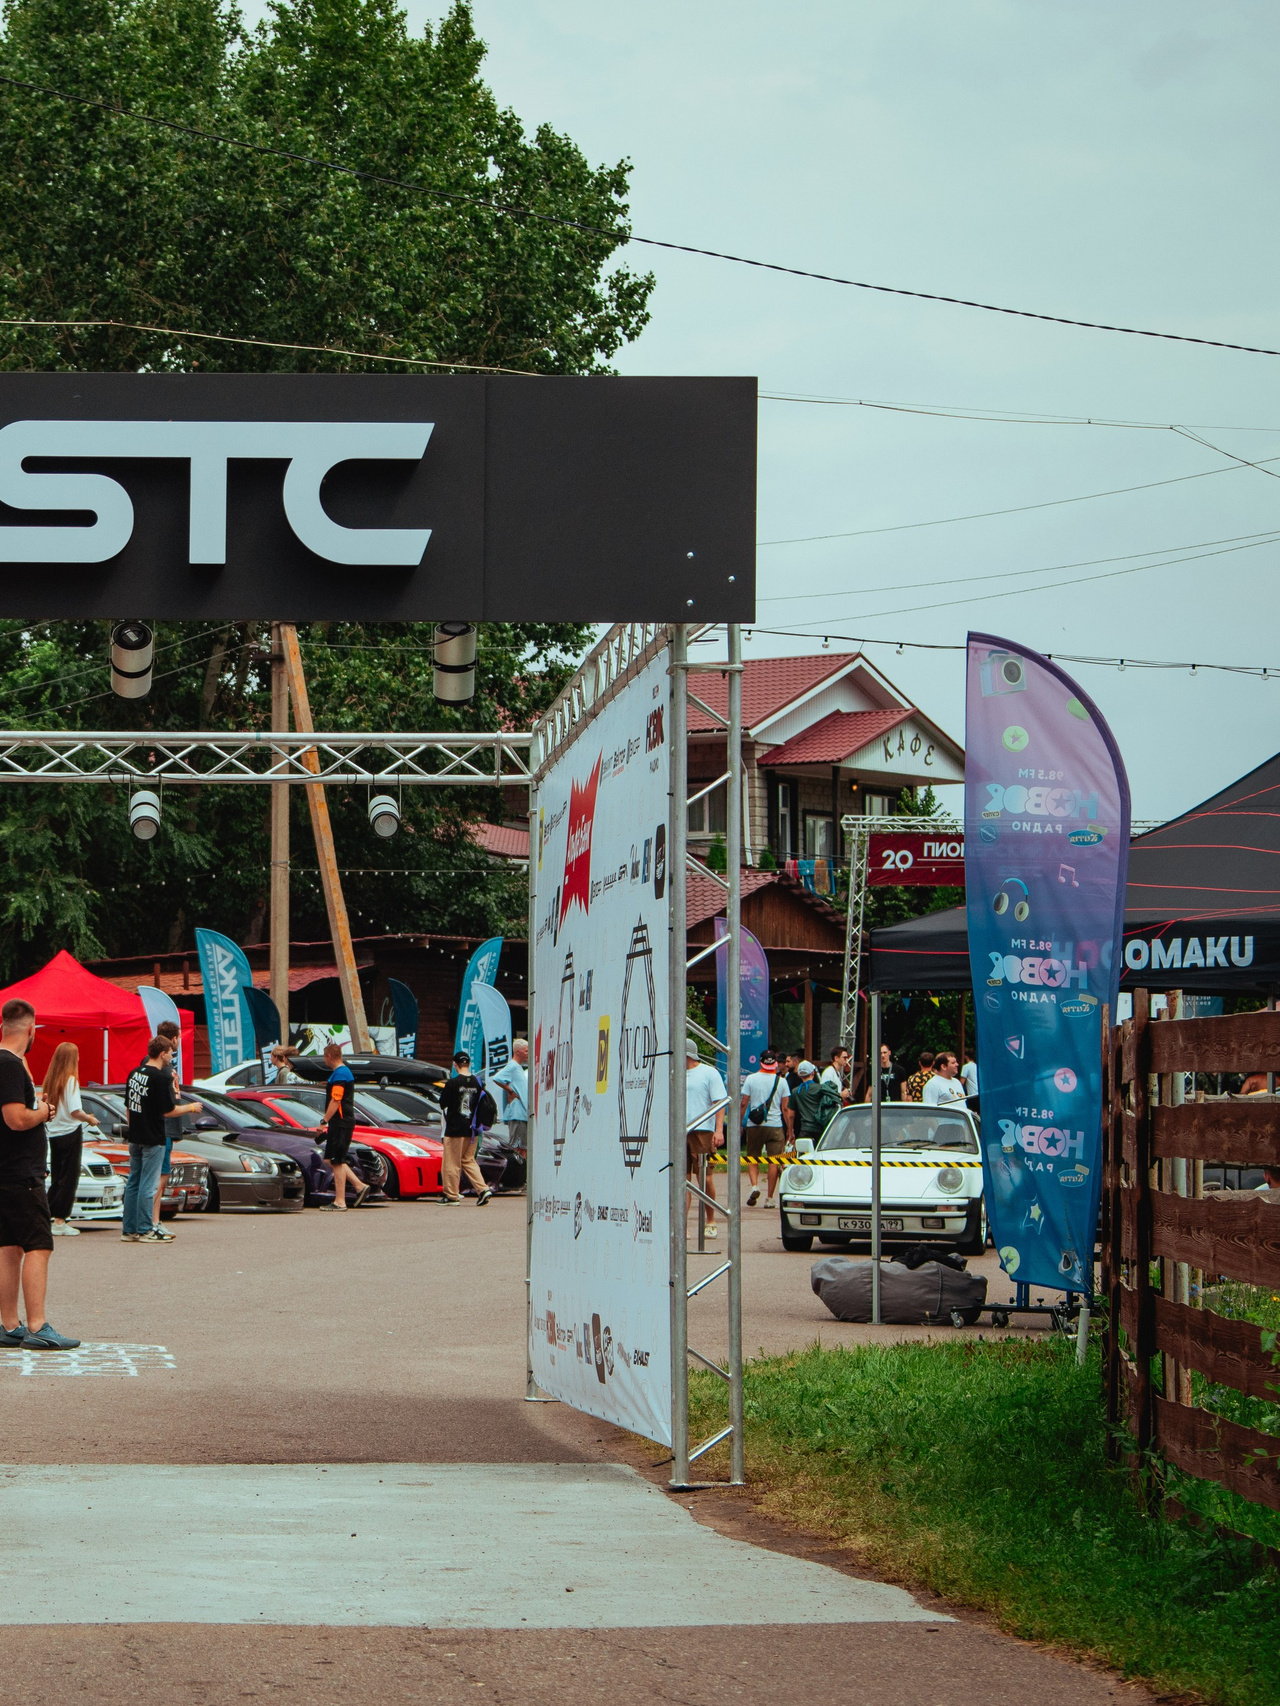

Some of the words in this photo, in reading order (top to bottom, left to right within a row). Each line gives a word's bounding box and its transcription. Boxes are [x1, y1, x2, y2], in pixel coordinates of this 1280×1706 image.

[923, 842, 965, 858] ПИО
[1120, 936, 1254, 970] OMAKU
[132, 1072, 149, 1086] ANTI
[128, 1079, 149, 1096] STOCK
[128, 1089, 141, 1104] CAR
